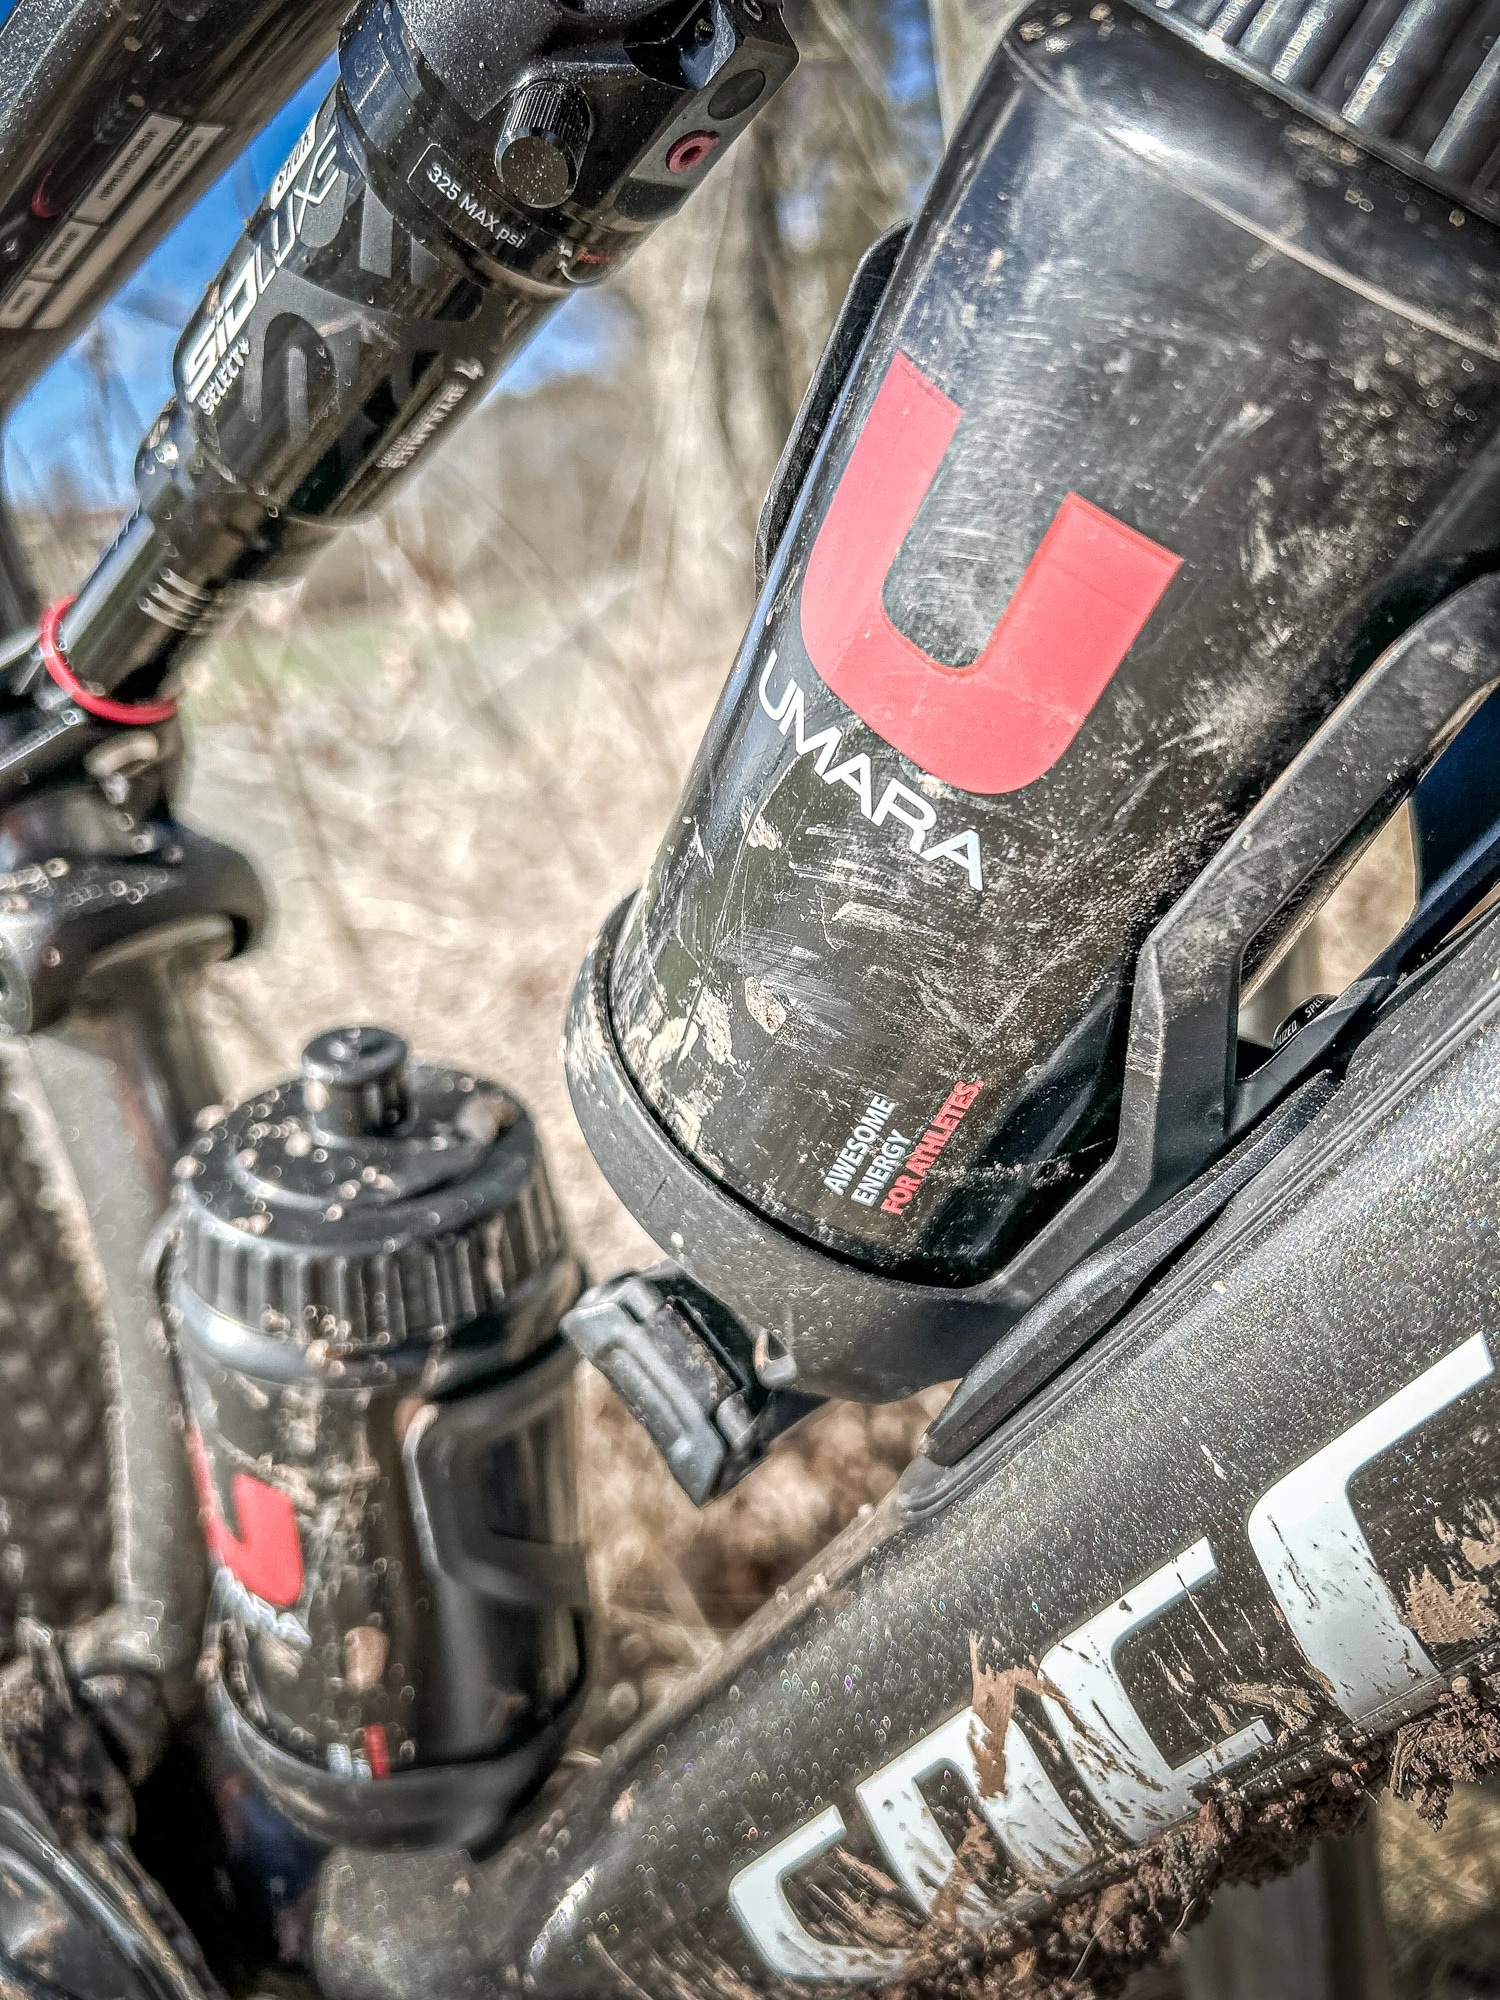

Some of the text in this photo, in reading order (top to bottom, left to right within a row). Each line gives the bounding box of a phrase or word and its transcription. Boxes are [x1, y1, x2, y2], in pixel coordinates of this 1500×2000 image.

[424, 165, 526, 253] 325 MAX psi
[758, 650, 984, 891] UMARA
[823, 1092, 897, 1196] AWESOME
[850, 1127, 912, 1207] ENERGY
[879, 1173, 922, 1214] FOR
